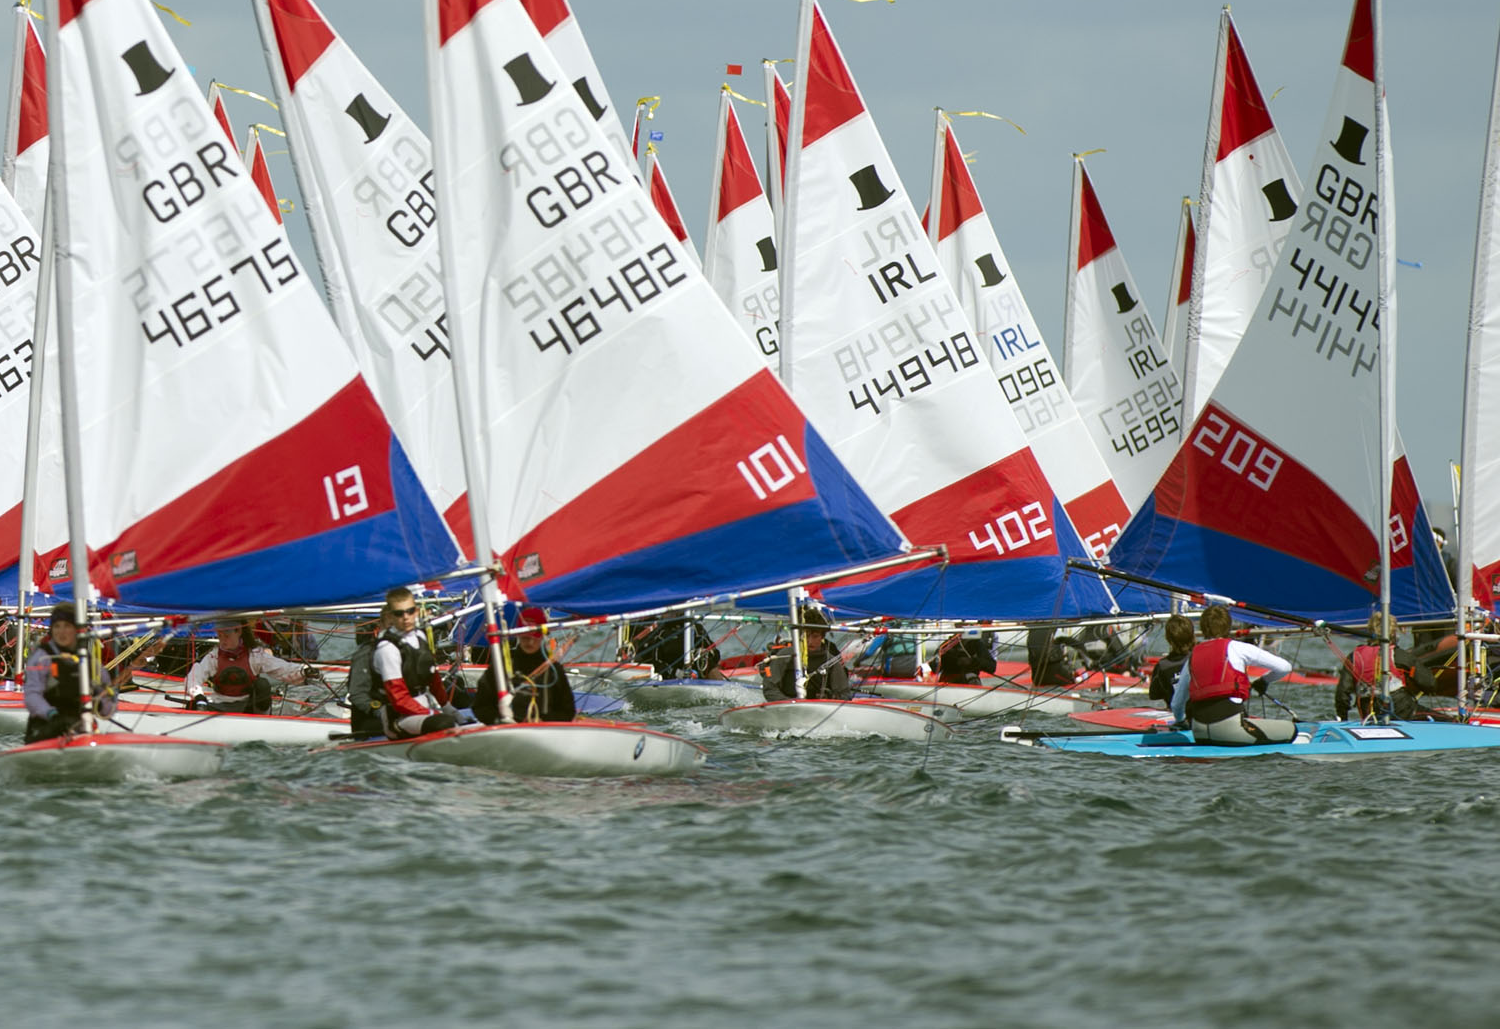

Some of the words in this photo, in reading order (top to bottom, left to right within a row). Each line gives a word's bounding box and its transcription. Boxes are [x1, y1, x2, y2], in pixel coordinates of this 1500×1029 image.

[142, 141, 238, 223] GBR
[526, 151, 621, 229] GBR
[142, 237, 300, 348] 46575
[529, 243, 687, 354] 46482
[867, 253, 937, 305] IRL
[849, 331, 979, 415] 44948
[993, 324, 1041, 360] IRL
[1128, 345, 1168, 380] IRL
[998, 357, 1057, 404] 096
[737, 434, 806, 500] 101
[1192, 412, 1284, 492] 209
[323, 464, 369, 521] 13
[968, 500, 1053, 556] 402
